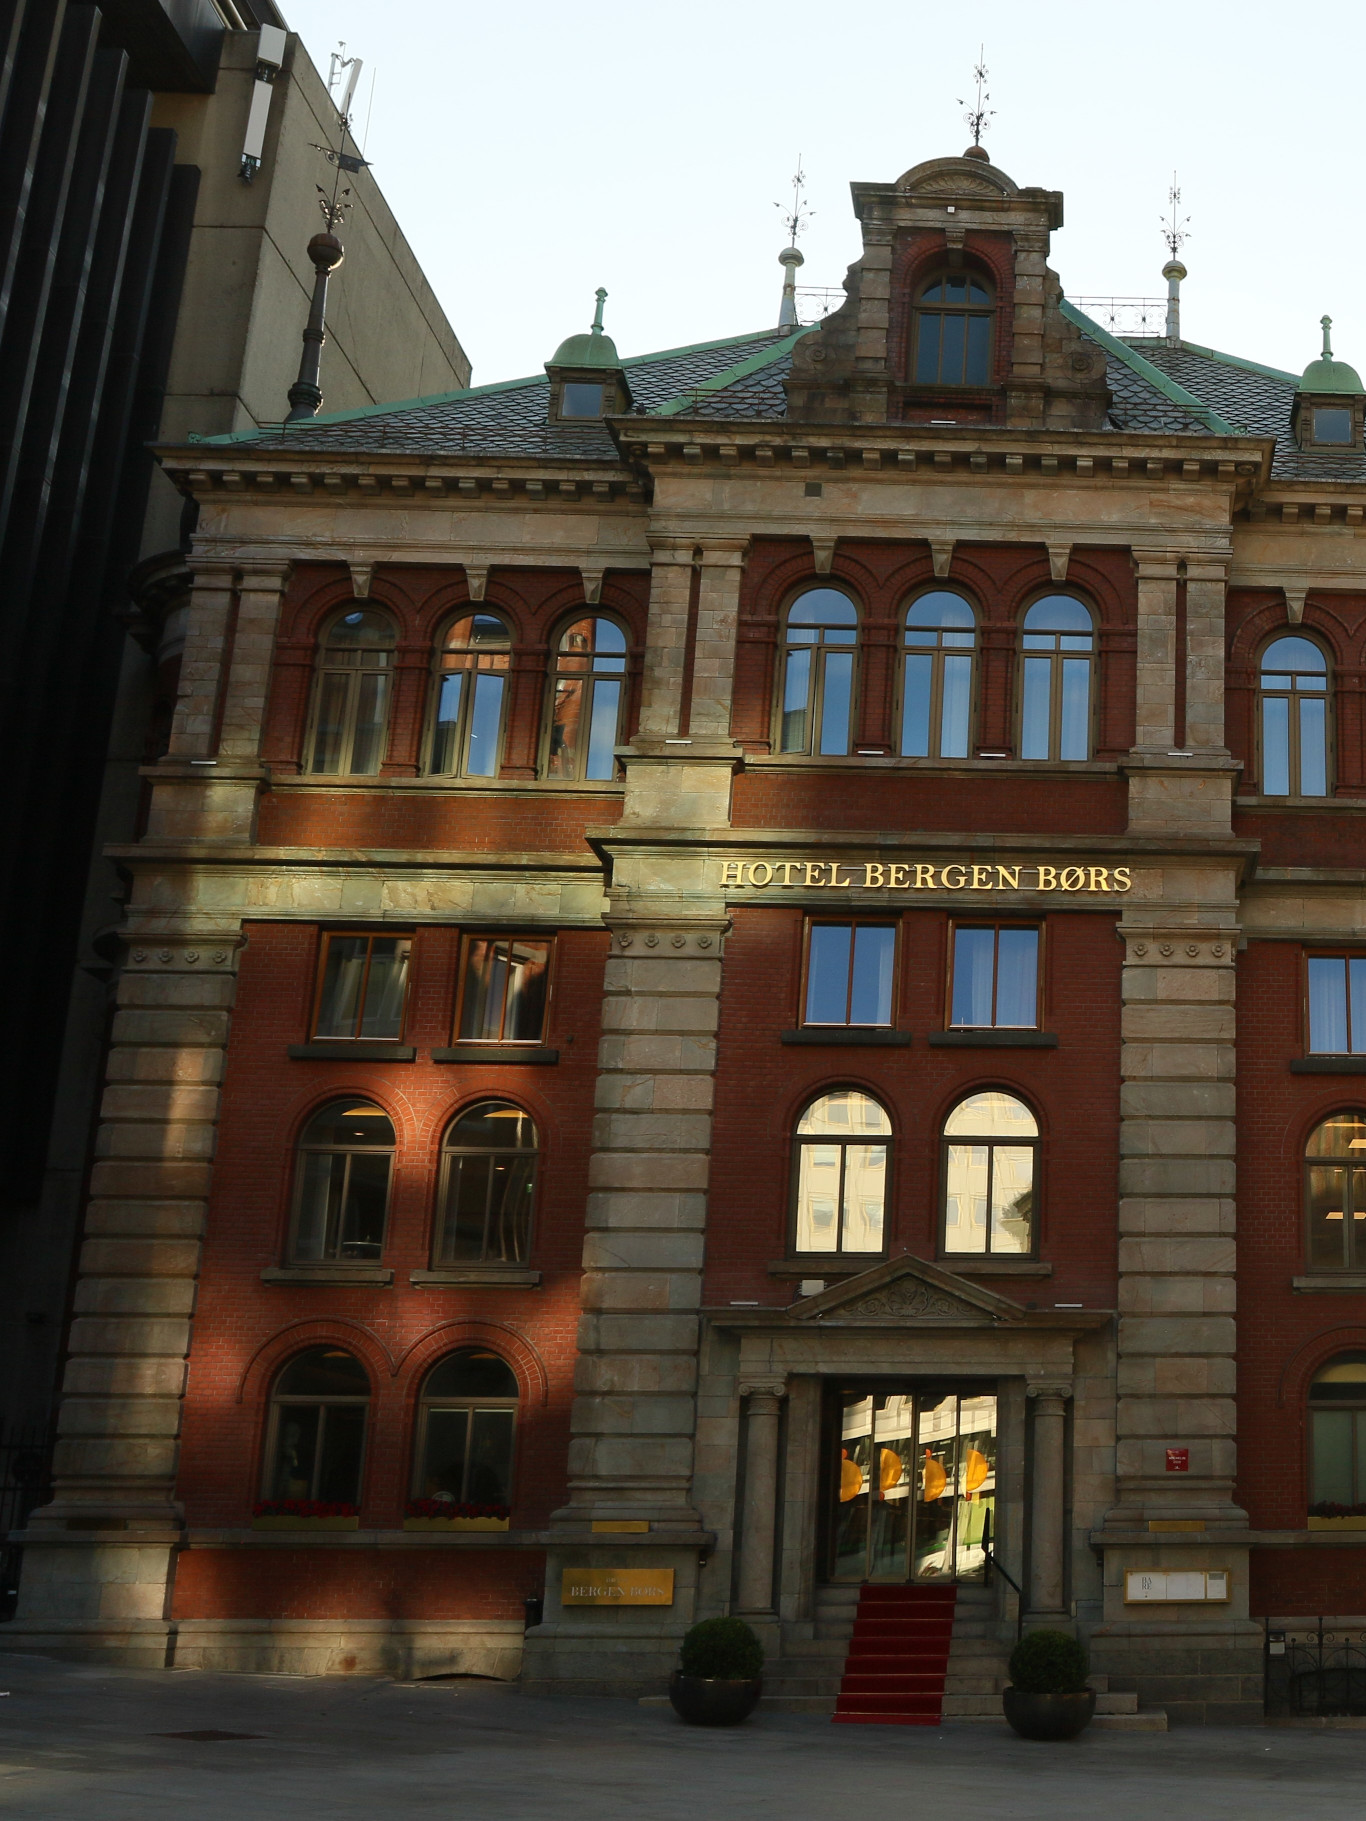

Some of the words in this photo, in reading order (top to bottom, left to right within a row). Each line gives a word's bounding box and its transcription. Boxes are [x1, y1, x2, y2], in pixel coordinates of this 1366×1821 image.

[718, 860, 850, 887] HOTEL
[862, 863, 1022, 890] BERGEN
[1036, 866, 1132, 892] BØRS
[571, 1586, 625, 1597] BERGEN
